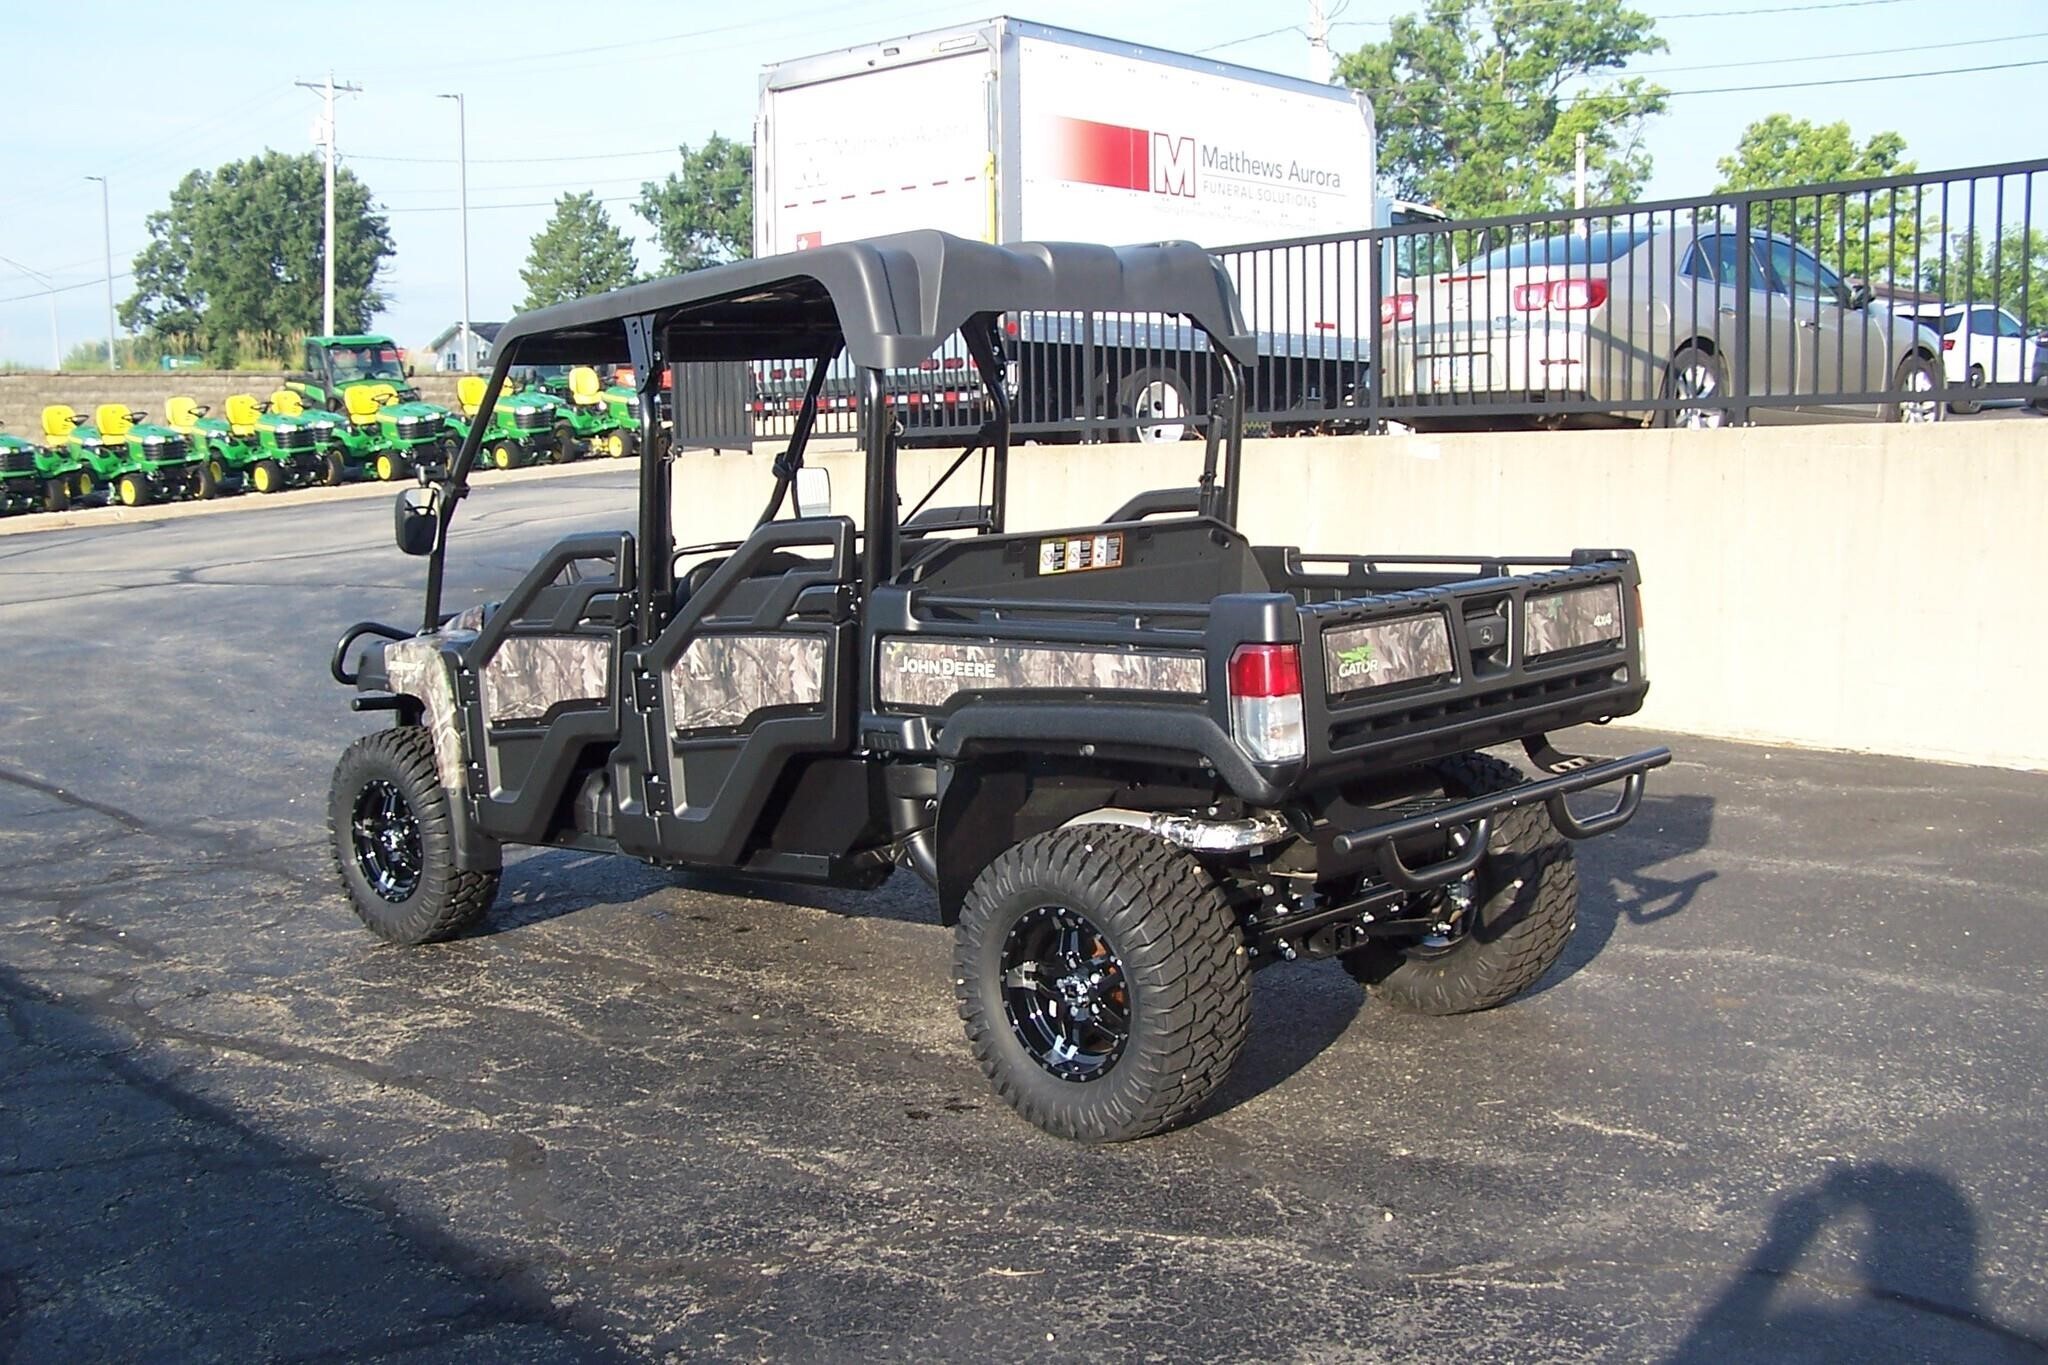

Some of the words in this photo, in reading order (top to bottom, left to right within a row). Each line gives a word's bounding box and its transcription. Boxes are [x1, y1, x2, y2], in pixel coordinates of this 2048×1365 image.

[1154, 132, 1195, 198] M
[1202, 145, 1283, 179] Matthews
[1288, 160, 1341, 188] Aurora
[1203, 180, 1254, 200] FUNERAL
[1257, 188, 1318, 209] SOLUTIONS
[900, 656, 940, 674] JOHN
[943, 658, 996, 678] DEERE
[1338, 659, 1378, 678] GATOR
